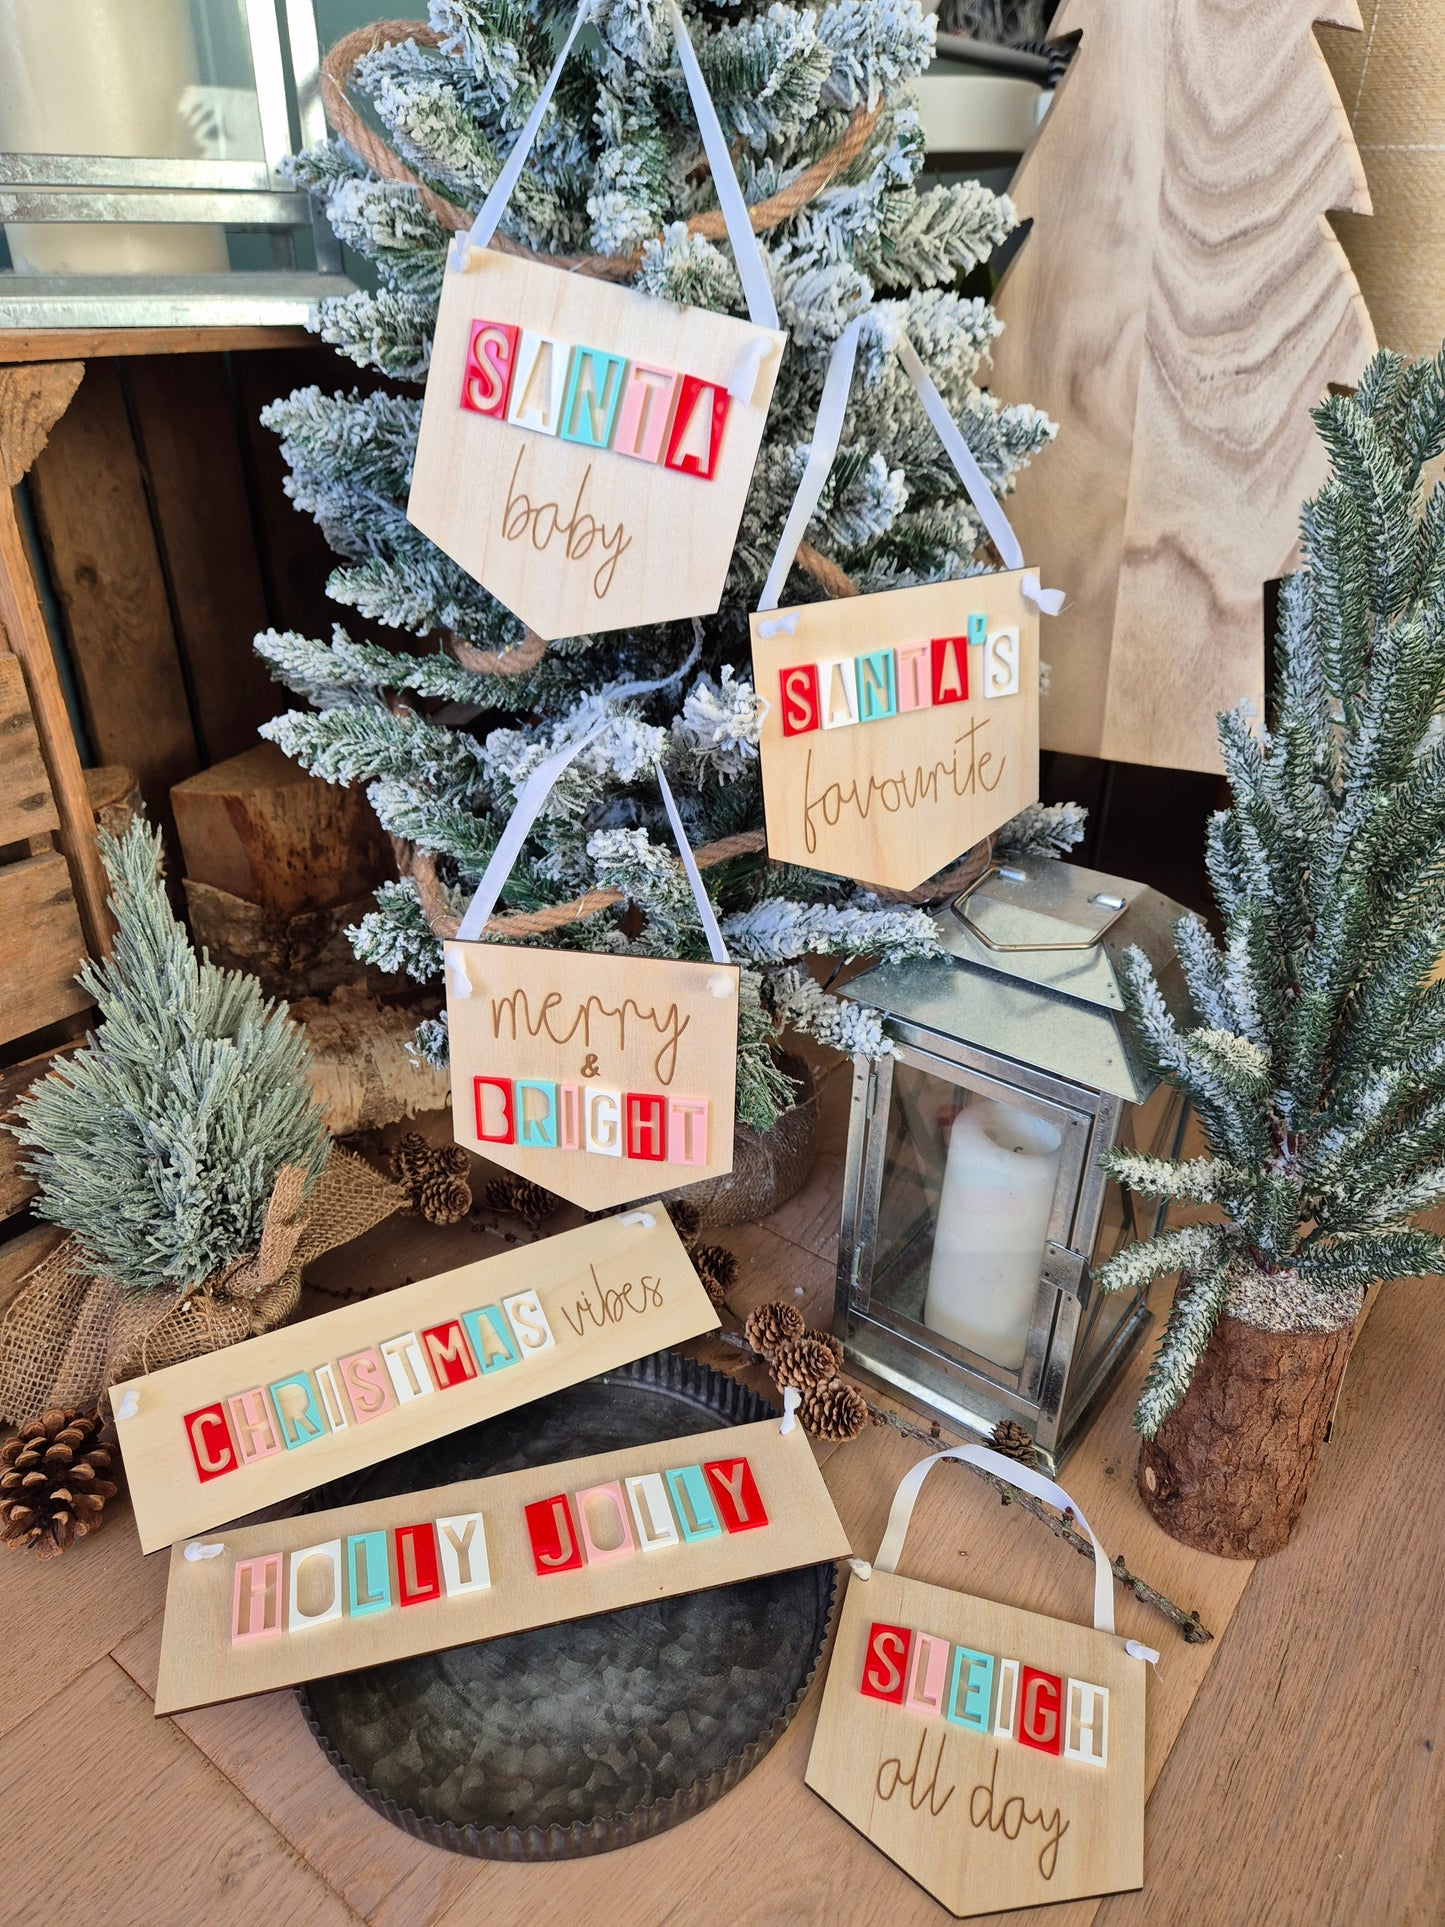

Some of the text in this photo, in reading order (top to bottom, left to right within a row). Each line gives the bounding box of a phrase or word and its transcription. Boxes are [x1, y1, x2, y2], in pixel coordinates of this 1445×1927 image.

[465, 324, 722, 477] SANTA
[501, 444, 633, 600] baby
[783, 615, 1017, 734] SANTA'S
[804, 716, 1007, 854] favourite
[491, 988, 691, 1086] merry
[580, 1053, 601, 1078] &
[476, 1079, 707, 1165] BRIGHT
[190, 1263, 665, 1479] CHRISTMAS vibes
[235, 1460, 758, 1640] HOLLY JOLLY
[865, 1627, 1106, 1762] SLEIGH
[876, 1727, 1070, 1881] all day
